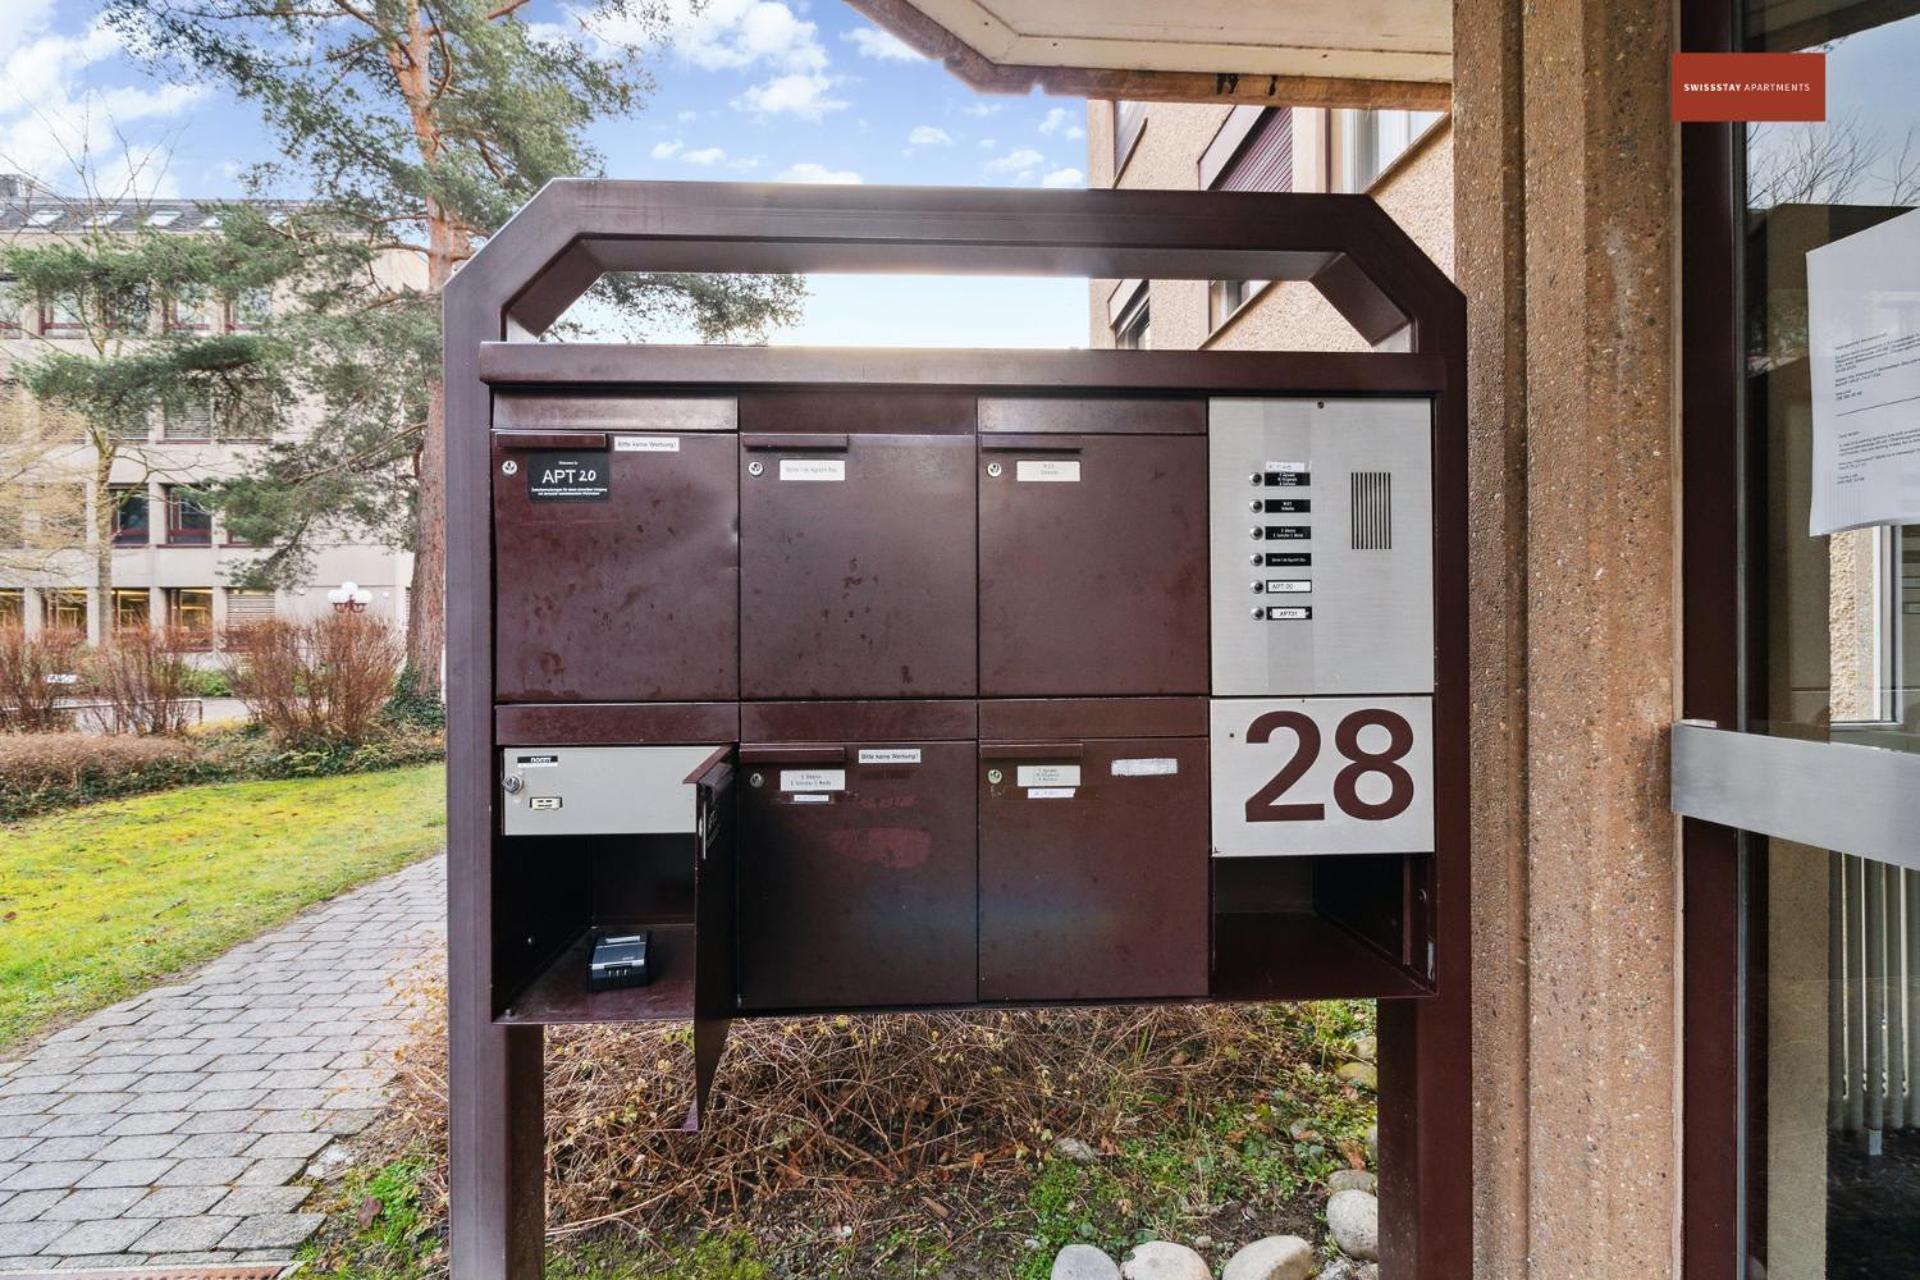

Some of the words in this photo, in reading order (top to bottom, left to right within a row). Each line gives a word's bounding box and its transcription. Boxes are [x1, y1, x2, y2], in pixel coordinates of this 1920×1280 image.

[542, 469, 576, 484] APT
[578, 470, 597, 482] 20
[1245, 708, 1414, 822] 28
